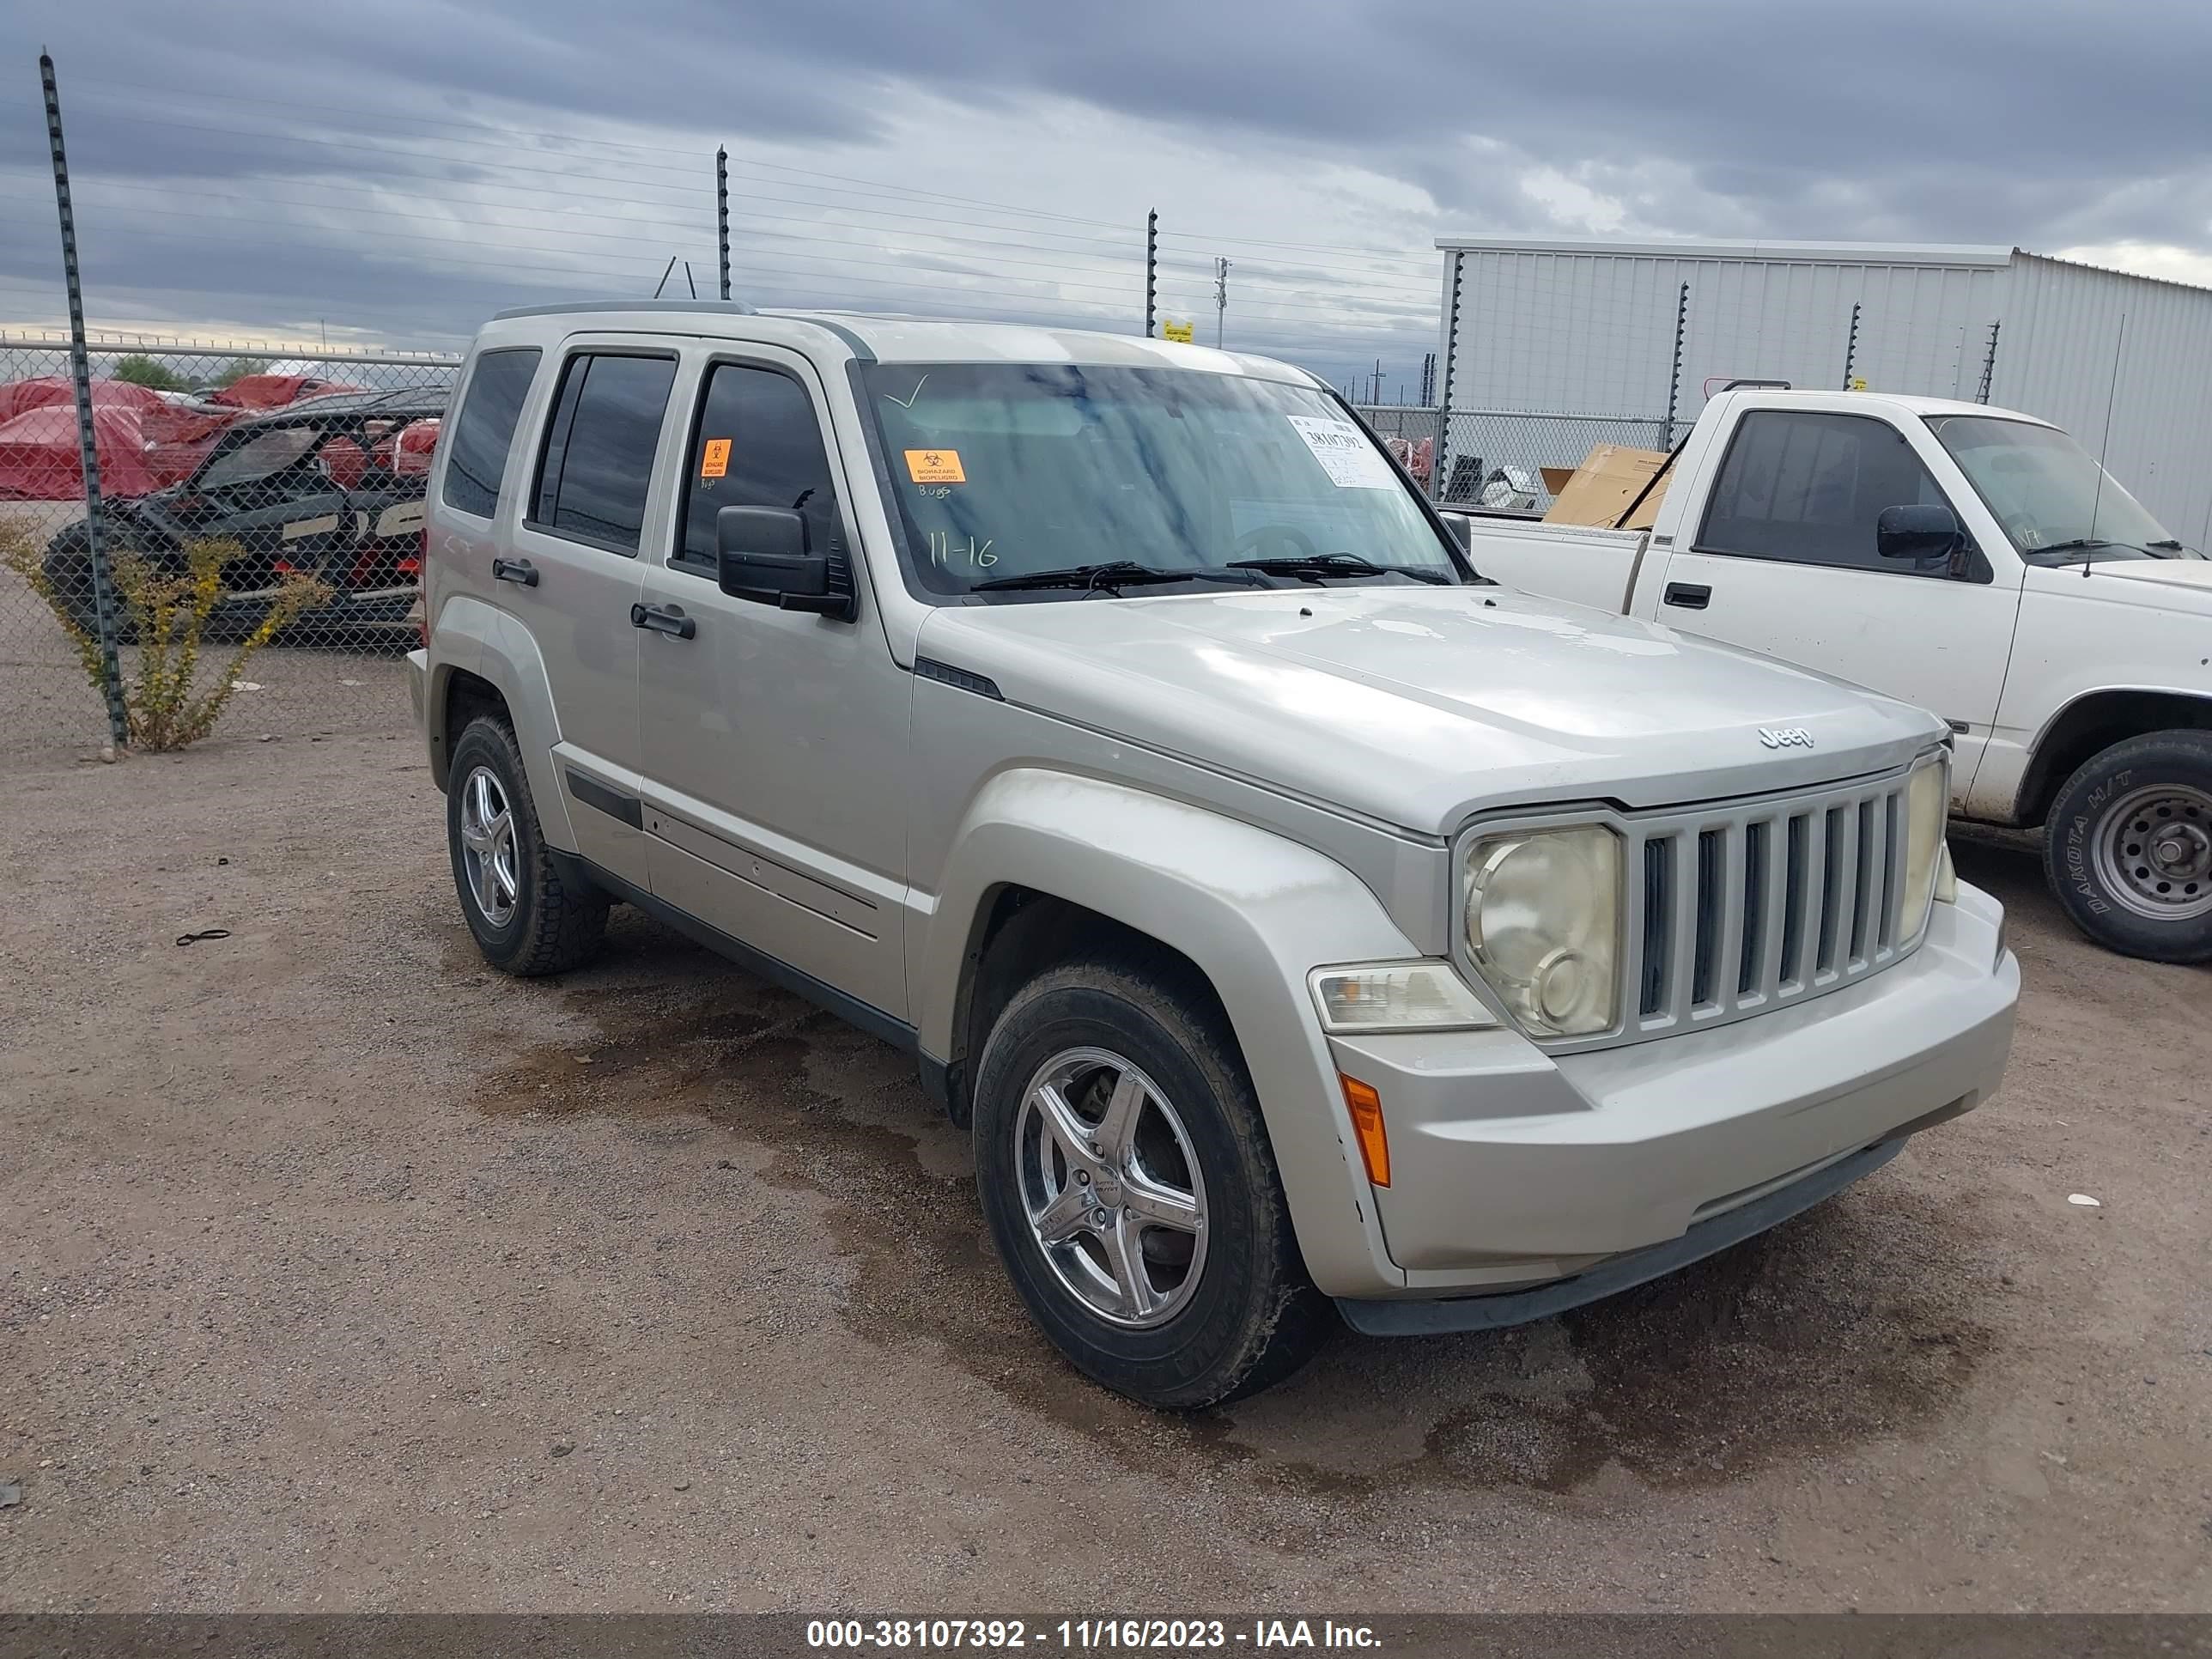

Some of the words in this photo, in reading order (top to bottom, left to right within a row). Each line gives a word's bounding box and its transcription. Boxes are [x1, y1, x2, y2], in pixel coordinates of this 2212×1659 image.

[1306, 431, 1364, 449] 38107392
[918, 484, 951, 499] Bugs
[930, 532, 999, 568] 11-16
[1758, 727, 1814, 750] Jeep
[2087, 769, 2132, 809] H/T
[2065, 816, 2112, 915] DAKOTA
